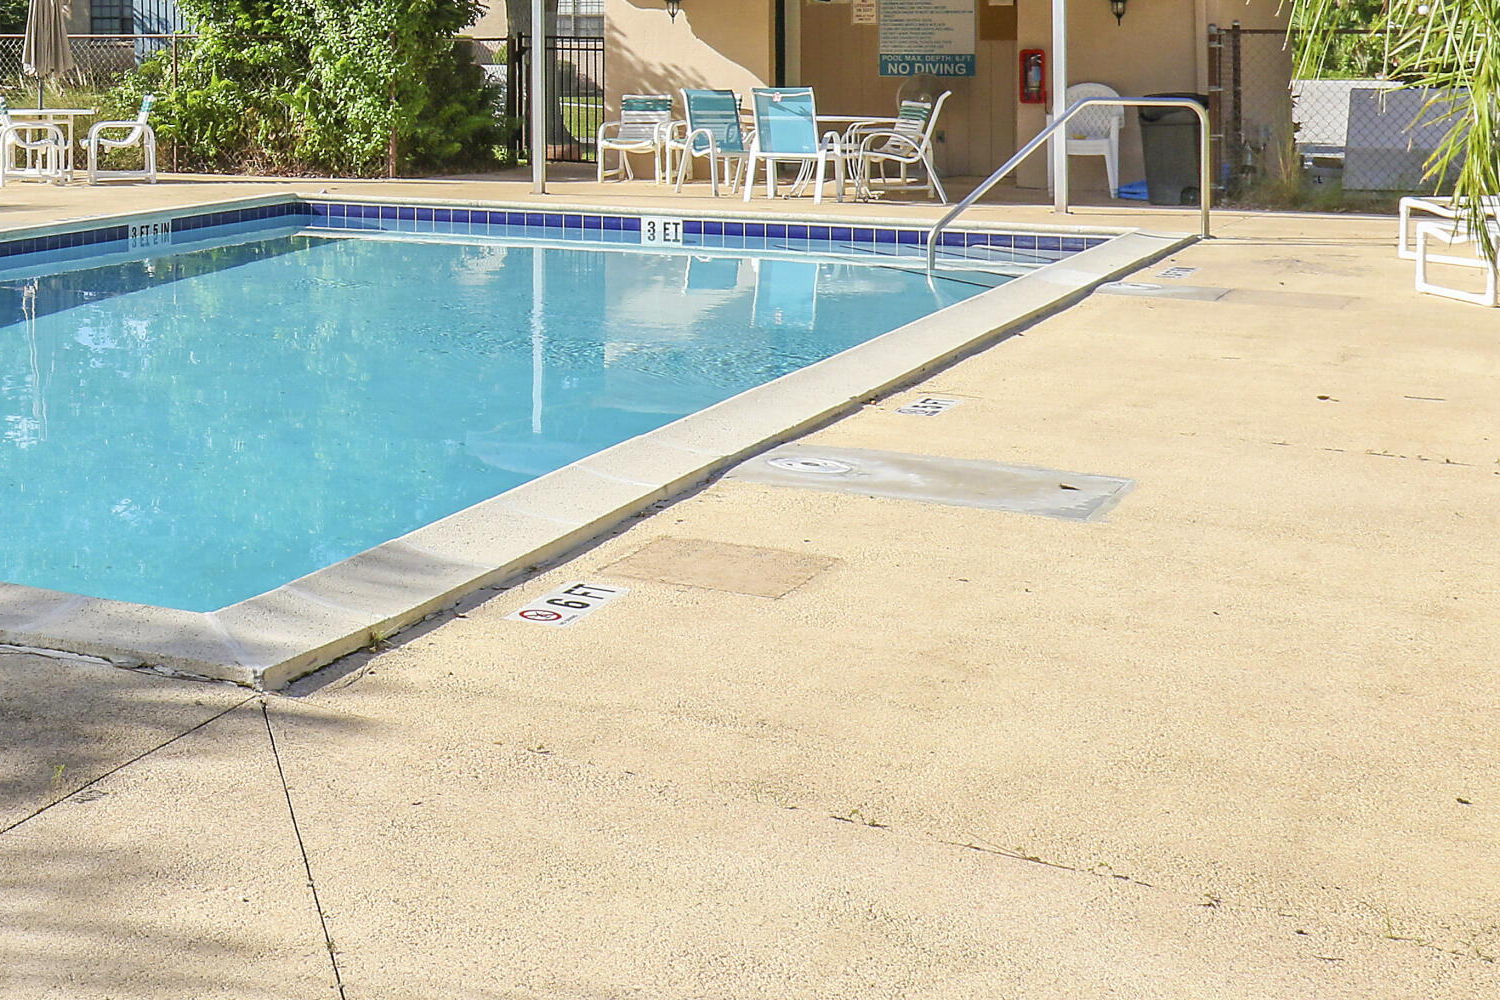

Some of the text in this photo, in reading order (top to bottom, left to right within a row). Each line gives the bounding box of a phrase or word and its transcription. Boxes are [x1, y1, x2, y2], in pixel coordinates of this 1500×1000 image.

[887, 63, 967, 75] NO DIVING
[131, 226, 137, 239] 3
[140, 224, 150, 238] FT
[161, 221, 170, 234] IN
[647, 221, 656, 241] 3
[546, 583, 616, 609] 6 FT
